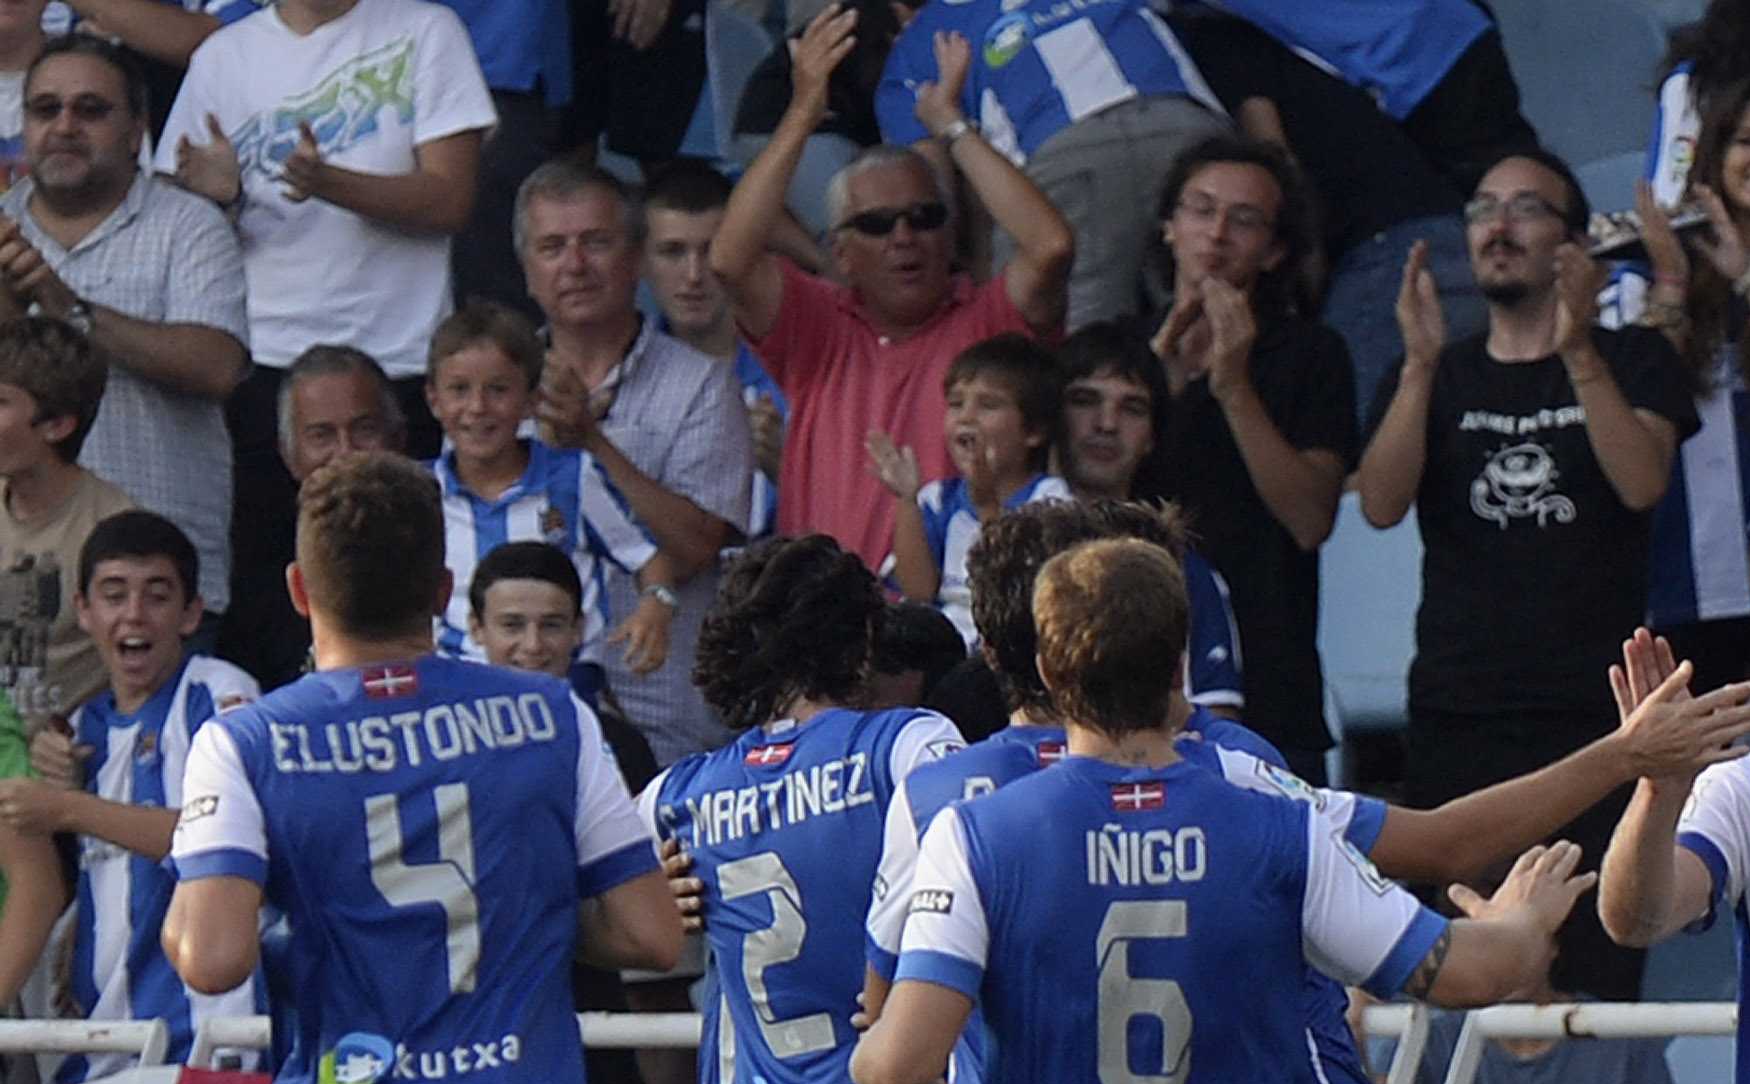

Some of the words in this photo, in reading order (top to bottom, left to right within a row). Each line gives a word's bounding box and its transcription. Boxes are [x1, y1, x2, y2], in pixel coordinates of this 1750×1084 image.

[269, 692, 556, 773] ELUSTONDO
[686, 752, 874, 849] MARTINEZ
[364, 782, 481, 993] 4
[1086, 823, 1206, 885] IÑIGO
[716, 851, 836, 1060] 2
[393, 1034, 521, 1080] kutxa
